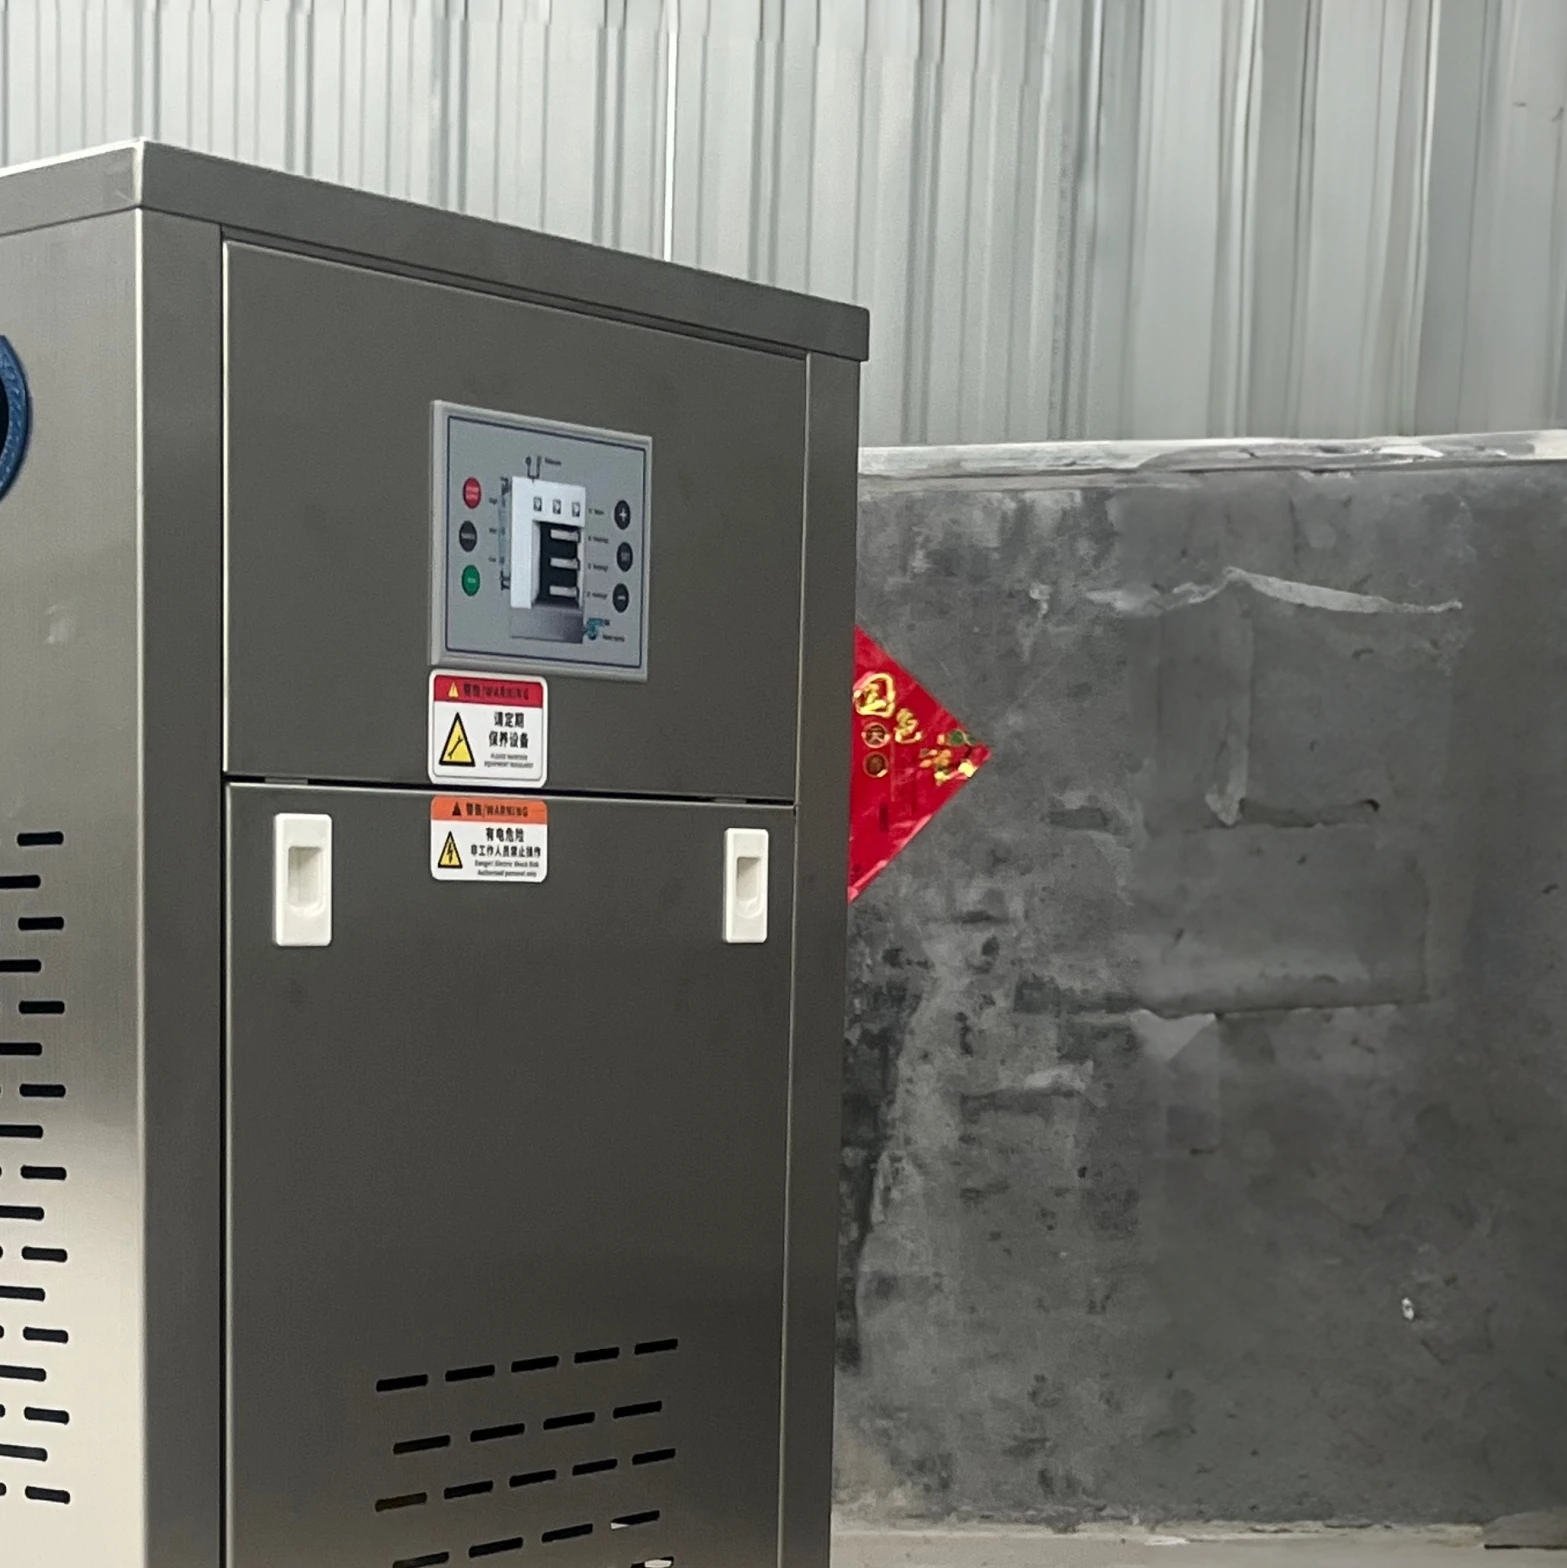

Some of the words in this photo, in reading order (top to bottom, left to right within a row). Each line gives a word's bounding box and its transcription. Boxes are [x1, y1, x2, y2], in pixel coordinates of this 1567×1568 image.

[489, 730, 528, 749] 保养设备
[485, 827, 524, 842] 有电危险
